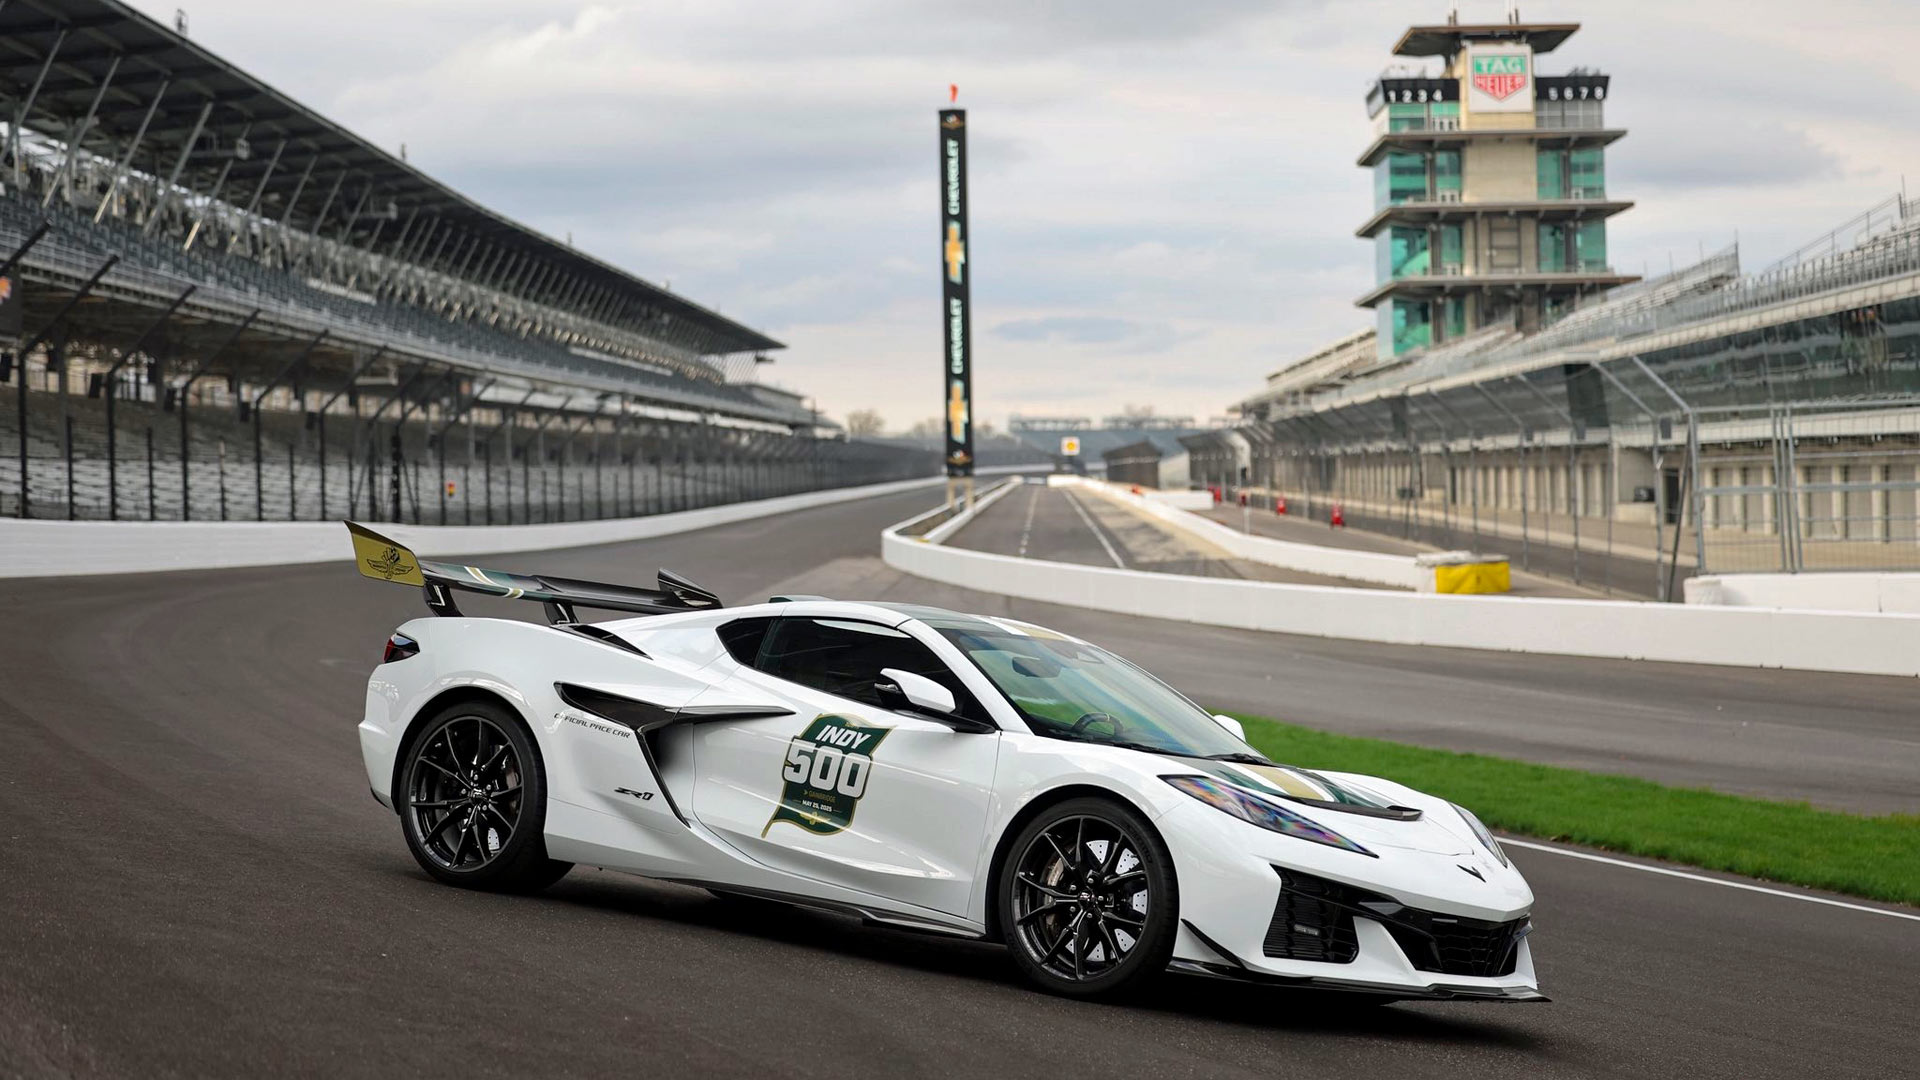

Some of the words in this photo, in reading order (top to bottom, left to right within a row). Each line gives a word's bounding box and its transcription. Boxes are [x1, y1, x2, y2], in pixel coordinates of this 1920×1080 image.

[1477, 58, 1522, 73] TAG
[1474, 76, 1525, 98] HEUER
[947, 138, 960, 215] CHEVROLET
[950, 298, 964, 374] CHEVROLET
[589, 723, 612, 734] PACE
[612, 729, 631, 738] CAR
[815, 724, 871, 749] INDY
[783, 738, 871, 798] 500
[802, 799, 812, 807] MAY
[820, 804, 832, 812] 2025
